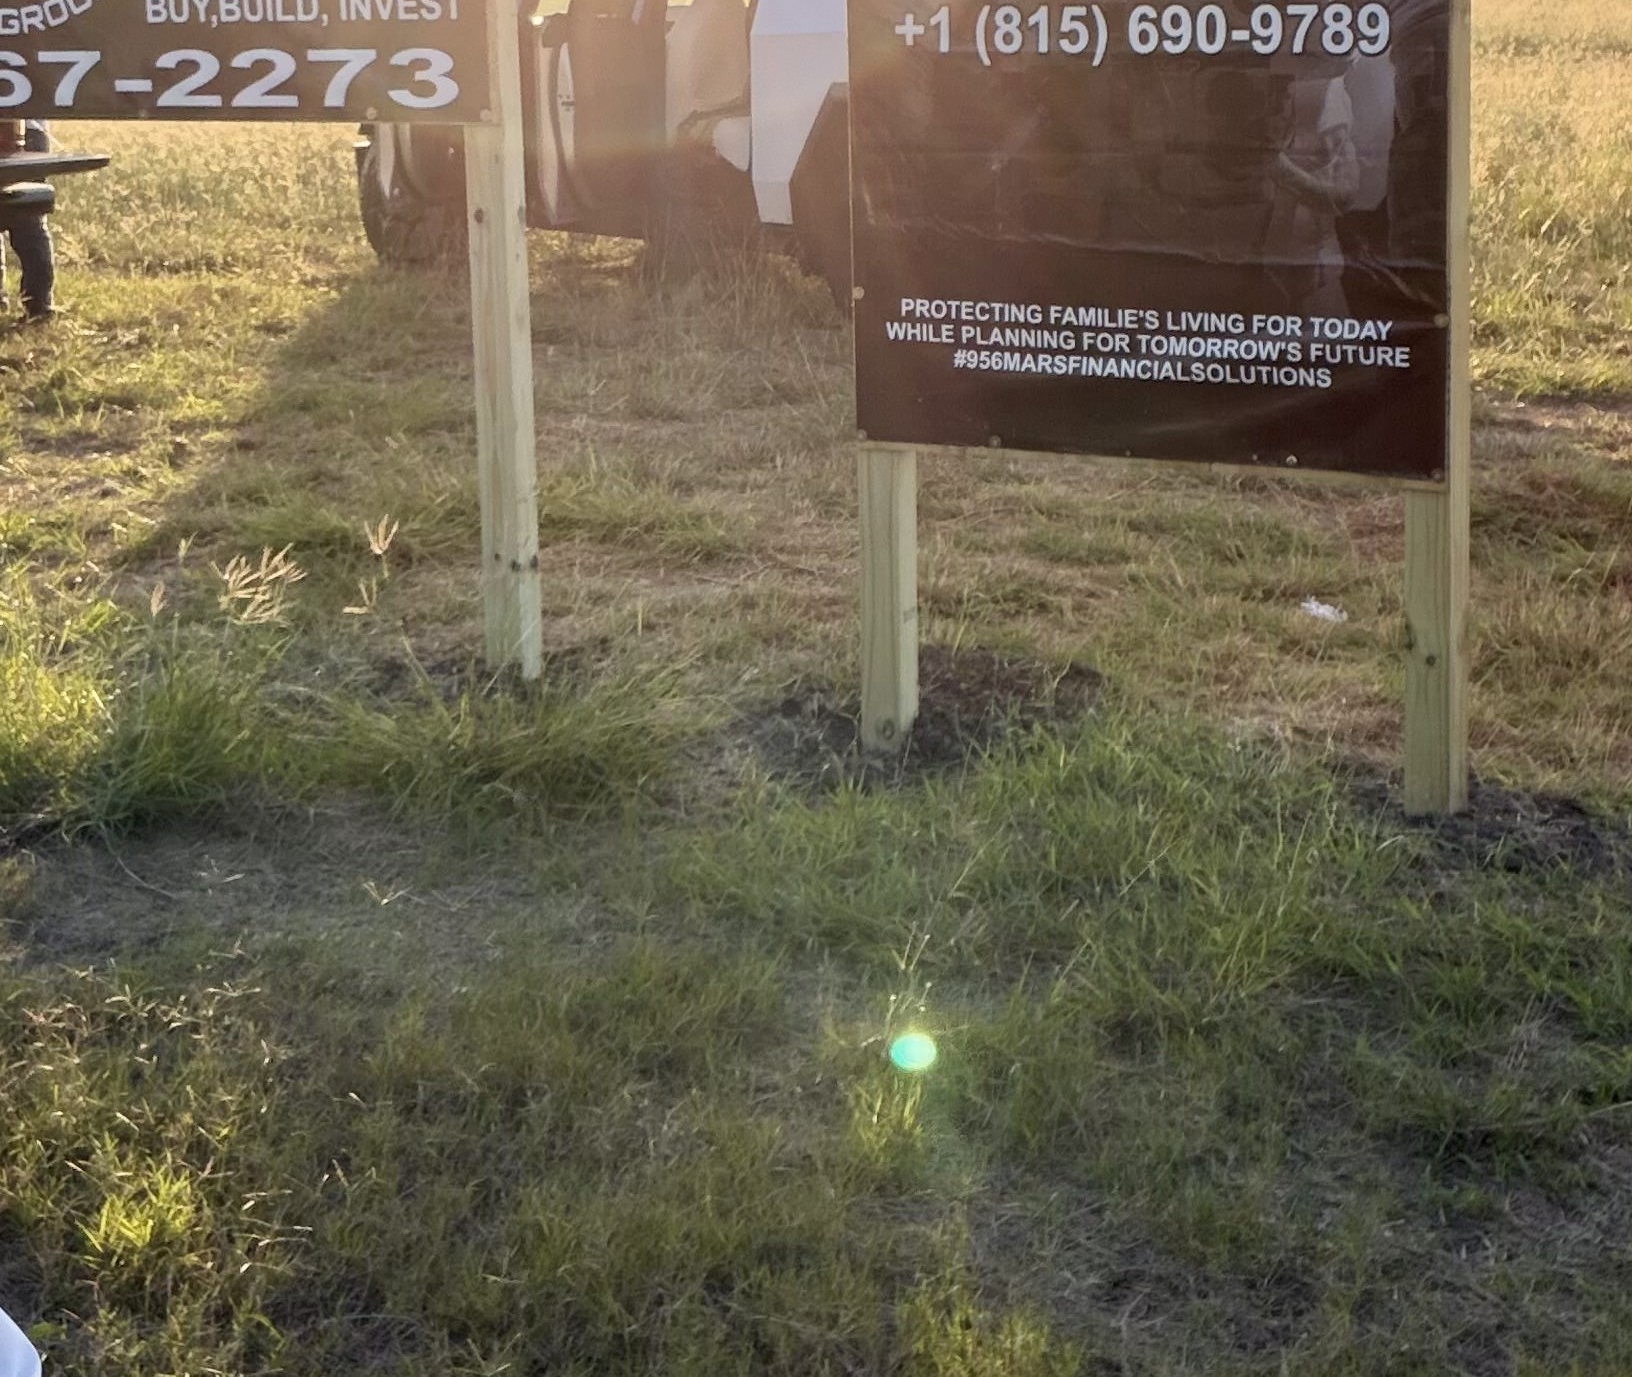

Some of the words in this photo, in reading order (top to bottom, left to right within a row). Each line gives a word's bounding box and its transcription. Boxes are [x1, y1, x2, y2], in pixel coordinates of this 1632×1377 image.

[895, 6, 952, 53] +1
[975, 5, 1108, 66] (815)
[1128, 4, 1392, 55] 690-9789
[900, 298, 1043, 325] PROTECTING
[1049, 305, 1160, 330] FAMILIE'S
[1166, 311, 1245, 334] LIVING
[1251, 314, 1303, 337] FOR
[1310, 317, 1393, 341] TODAY
[885, 321, 956, 344] WHILE
[961, 326, 1076, 352] PLANNING
[1082, 332, 1131, 354] FOR
[1137, 334, 1302, 363] TOMORROW'S
[1309, 346, 1411, 369] FUTURE
[953, 349, 1333, 388] #956MARSFINANCIALSOLUTIONS
